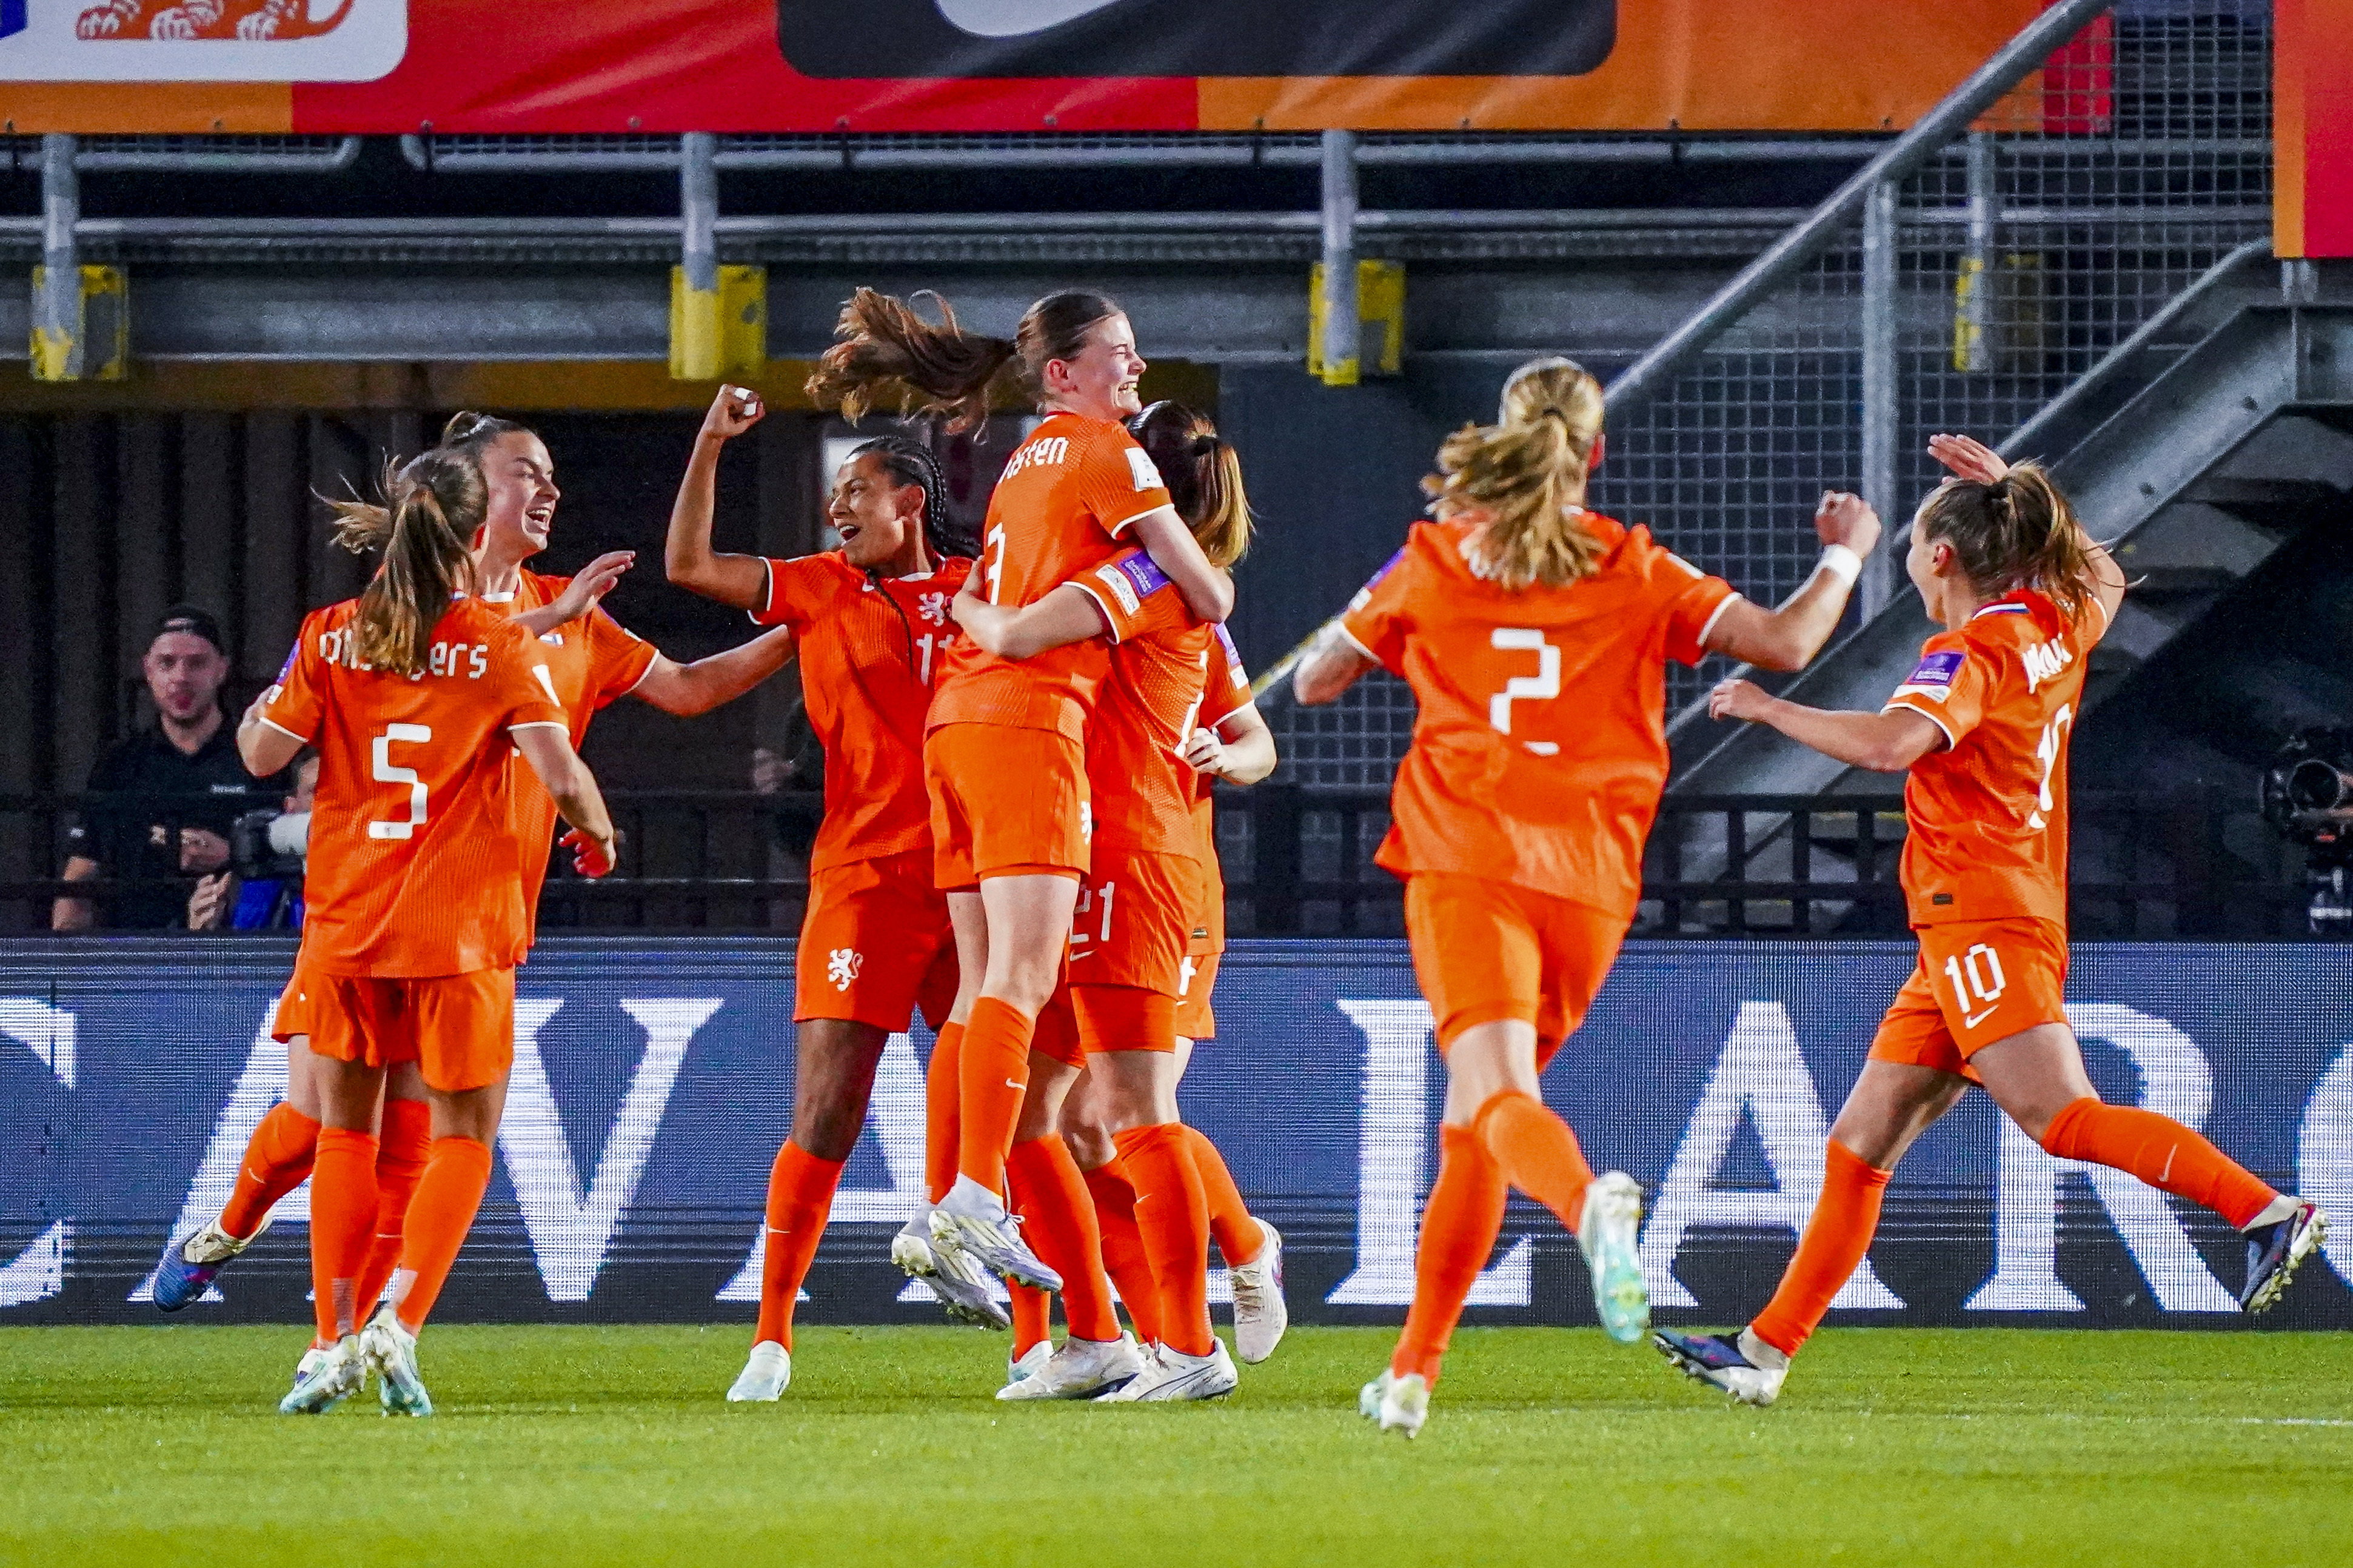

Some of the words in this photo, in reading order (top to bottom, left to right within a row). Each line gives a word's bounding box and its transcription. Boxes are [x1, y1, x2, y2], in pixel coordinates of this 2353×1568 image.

[1490, 629, 1561, 756] 2
[369, 723, 432, 839] 5
[1944, 942, 2007, 1014] 10
